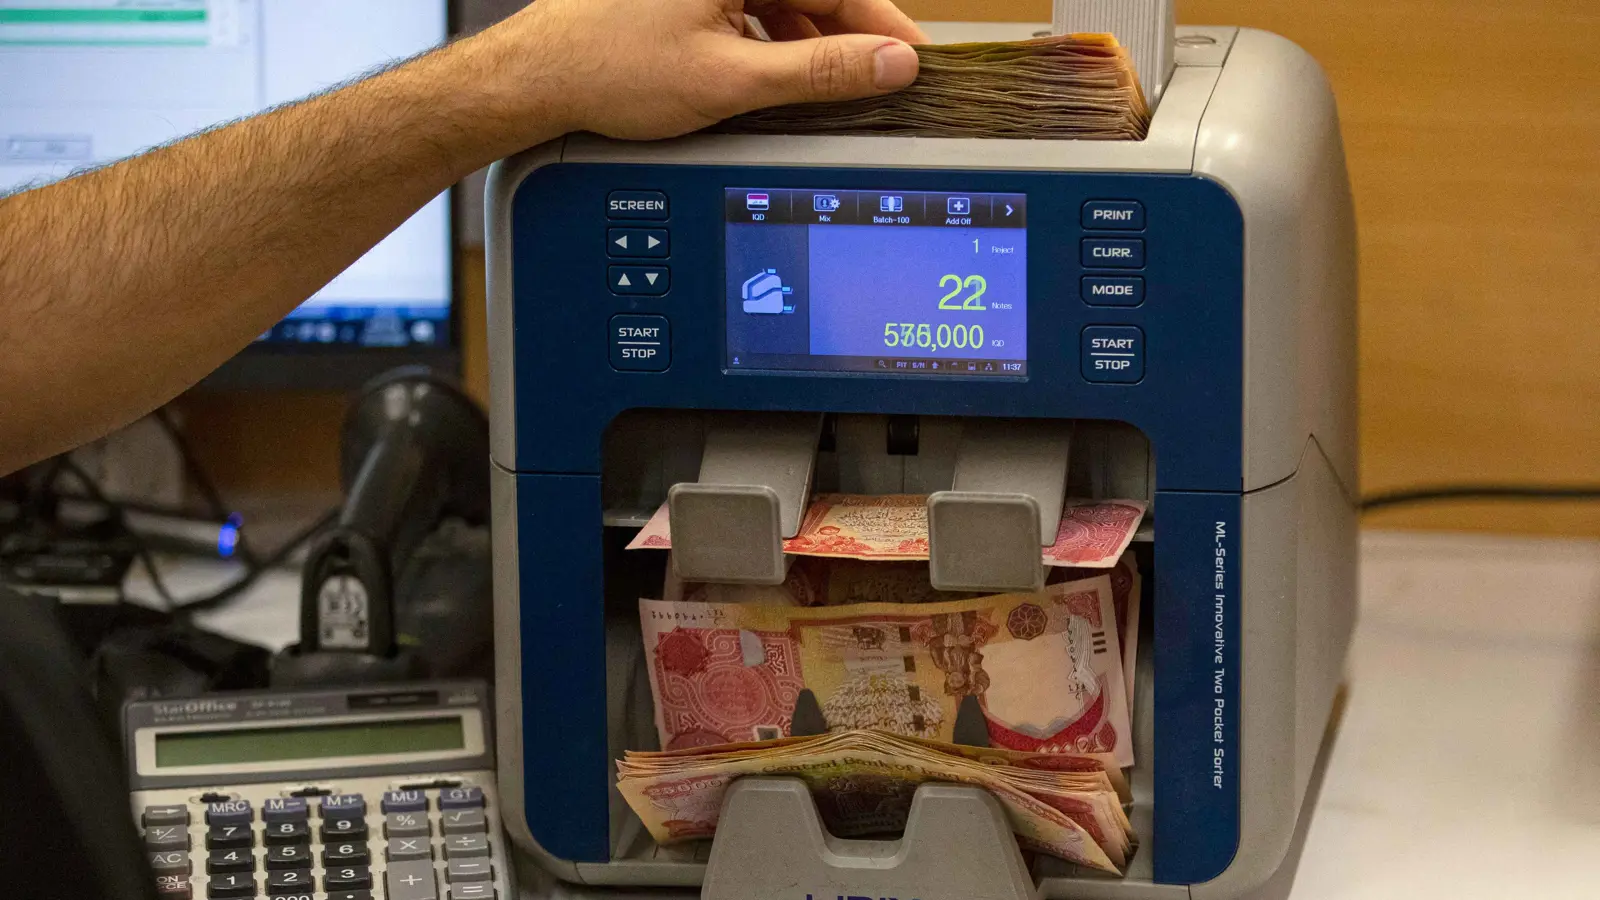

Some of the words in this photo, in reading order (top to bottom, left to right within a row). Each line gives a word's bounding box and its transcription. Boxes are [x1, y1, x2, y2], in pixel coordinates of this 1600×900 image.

[610, 200, 664, 211] SCREEN
[752, 213, 765, 221] IQD
[819, 215, 831, 223] Mix
[873, 216, 910, 224] Batch-100
[1093, 209, 1134, 221] PRINT
[945, 217, 959, 226] Add
[961, 218, 972, 226] Off
[972, 238, 979, 254] 1
[991, 246, 1014, 255] Reject
[1093, 247, 1133, 258] CURR.
[1092, 285, 1134, 296] MODE
[991, 302, 1013, 310] Notes
[618, 327, 660, 338] START
[1092, 338, 1134, 349] START
[622, 348, 656, 359] STOP
[1002, 363, 1022, 371] 11:37
[1095, 359, 1130, 370] STOP
[1215, 521, 1226, 590] ML-Series
[1214, 594, 1226, 664] Innovative
[1214, 668, 1225, 694] Two
[1213, 699, 1225, 744] Pocket
[762, 757, 838, 773] Central
[1213, 748, 1224, 789] Sorter
[391, 792, 418, 801] MU
[450, 790, 472, 799] GT
[211, 801, 247, 813] MRC
[280, 824, 295, 833] 8
[336, 820, 351, 830] 9
[223, 827, 238, 836] 7
[281, 847, 296, 857] 5
[339, 844, 354, 854] 6
[152, 853, 182, 864] AC
[224, 852, 239, 861] 4
[283, 872, 298, 882] 2
[340, 869, 355, 879] 3
[156, 875, 178, 884] ON
[226, 876, 236, 885] 1
